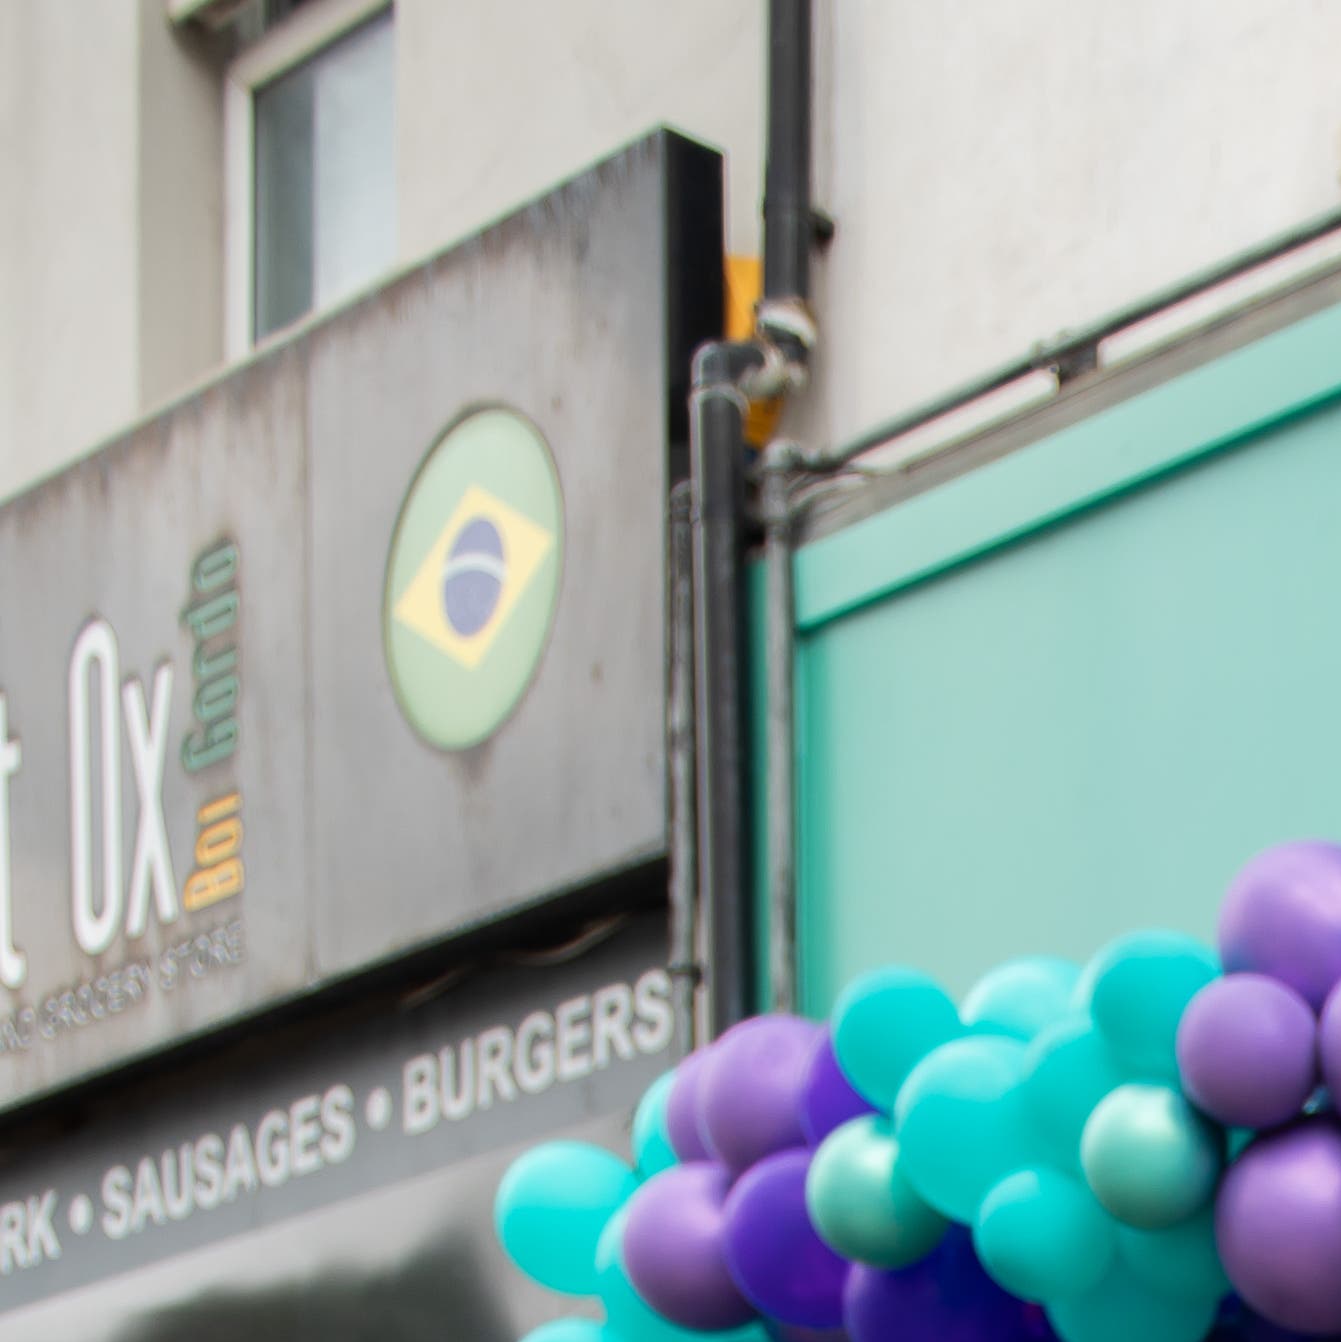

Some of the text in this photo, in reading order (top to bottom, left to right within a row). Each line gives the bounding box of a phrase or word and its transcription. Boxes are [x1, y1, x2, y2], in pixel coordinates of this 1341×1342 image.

[69, 617, 178, 955] Ox
[102, 1083, 355, 1240] SAUSAGES
[403, 968, 674, 1136] BURGERS
